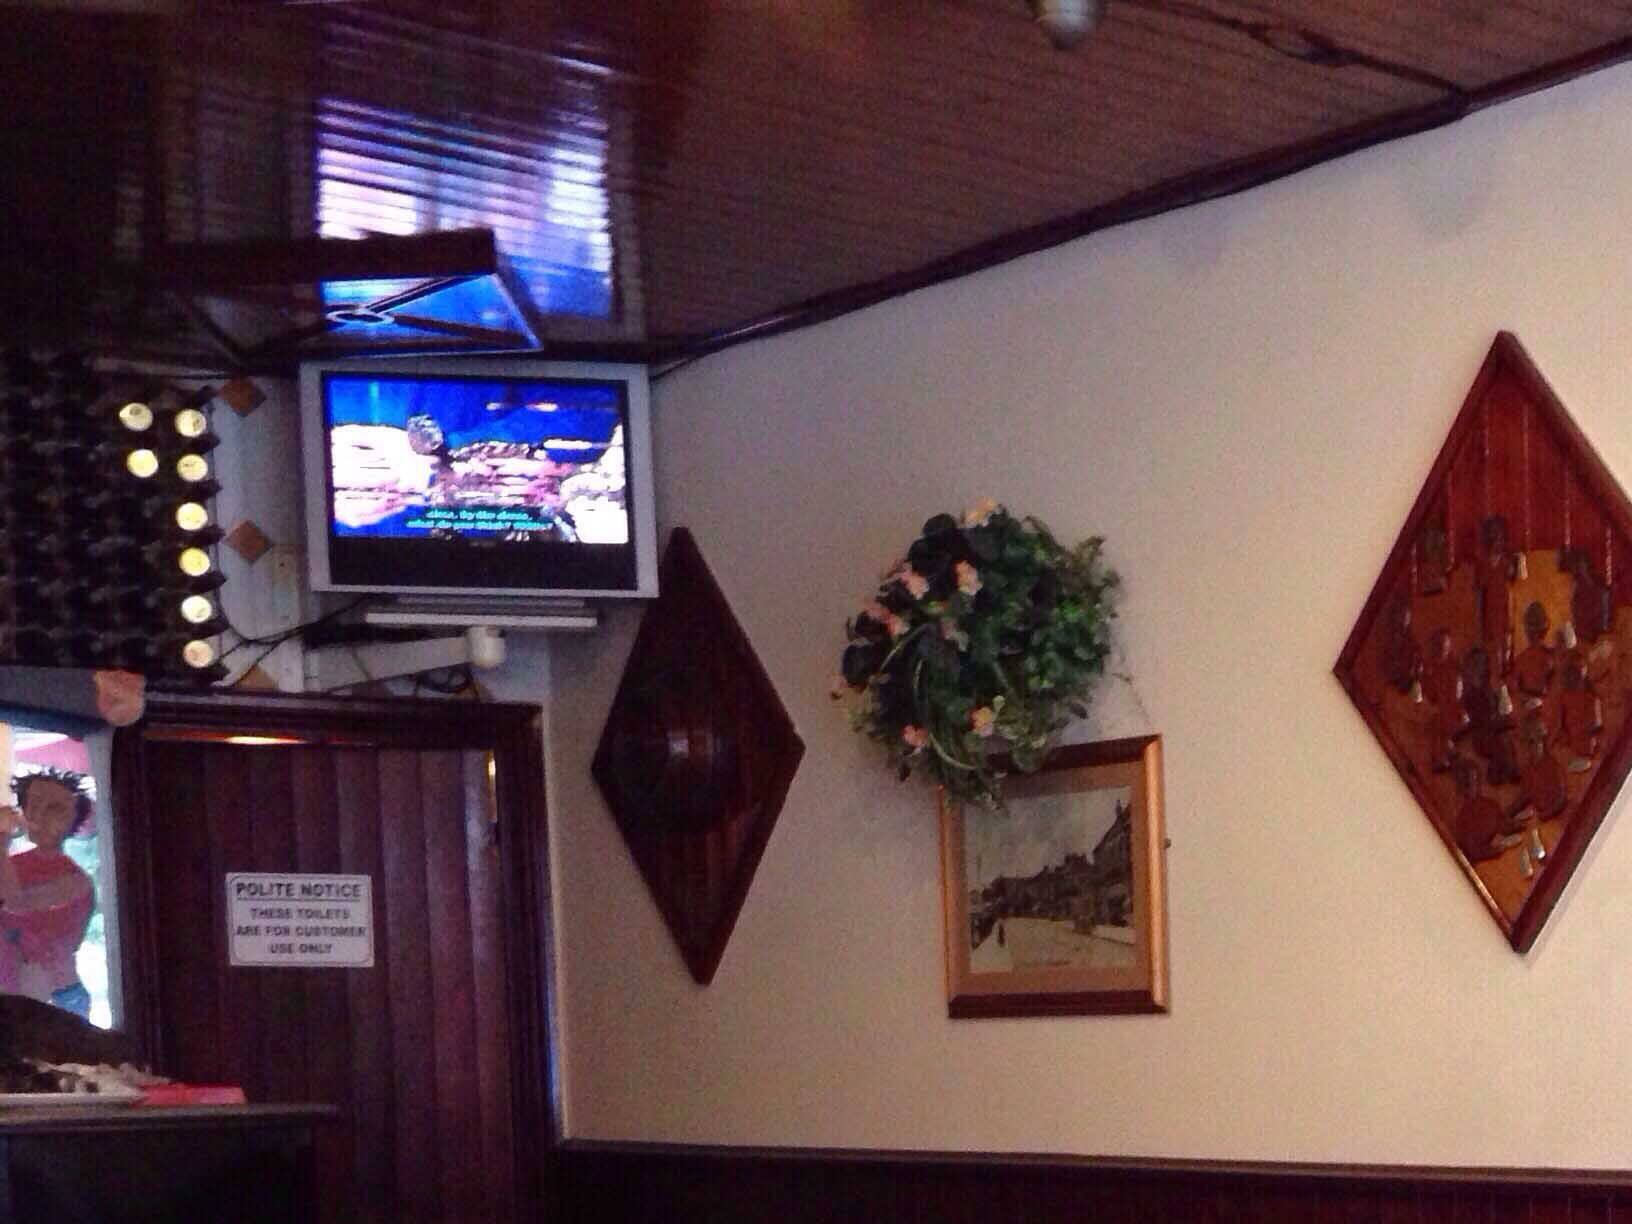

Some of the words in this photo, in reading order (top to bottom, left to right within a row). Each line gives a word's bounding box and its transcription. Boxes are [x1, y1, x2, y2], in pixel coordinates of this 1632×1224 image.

[236, 882, 295, 897] POLITE
[300, 882, 362, 897] NOTICE
[250, 907, 293, 919] THESE
[298, 908, 351, 919] TOILETS
[236, 925, 261, 936] ARE
[265, 925, 290, 936] FOR
[295, 926, 367, 937] CUSTOMER
[270, 943, 294, 954] USE
[299, 943, 333, 954] ONLY
